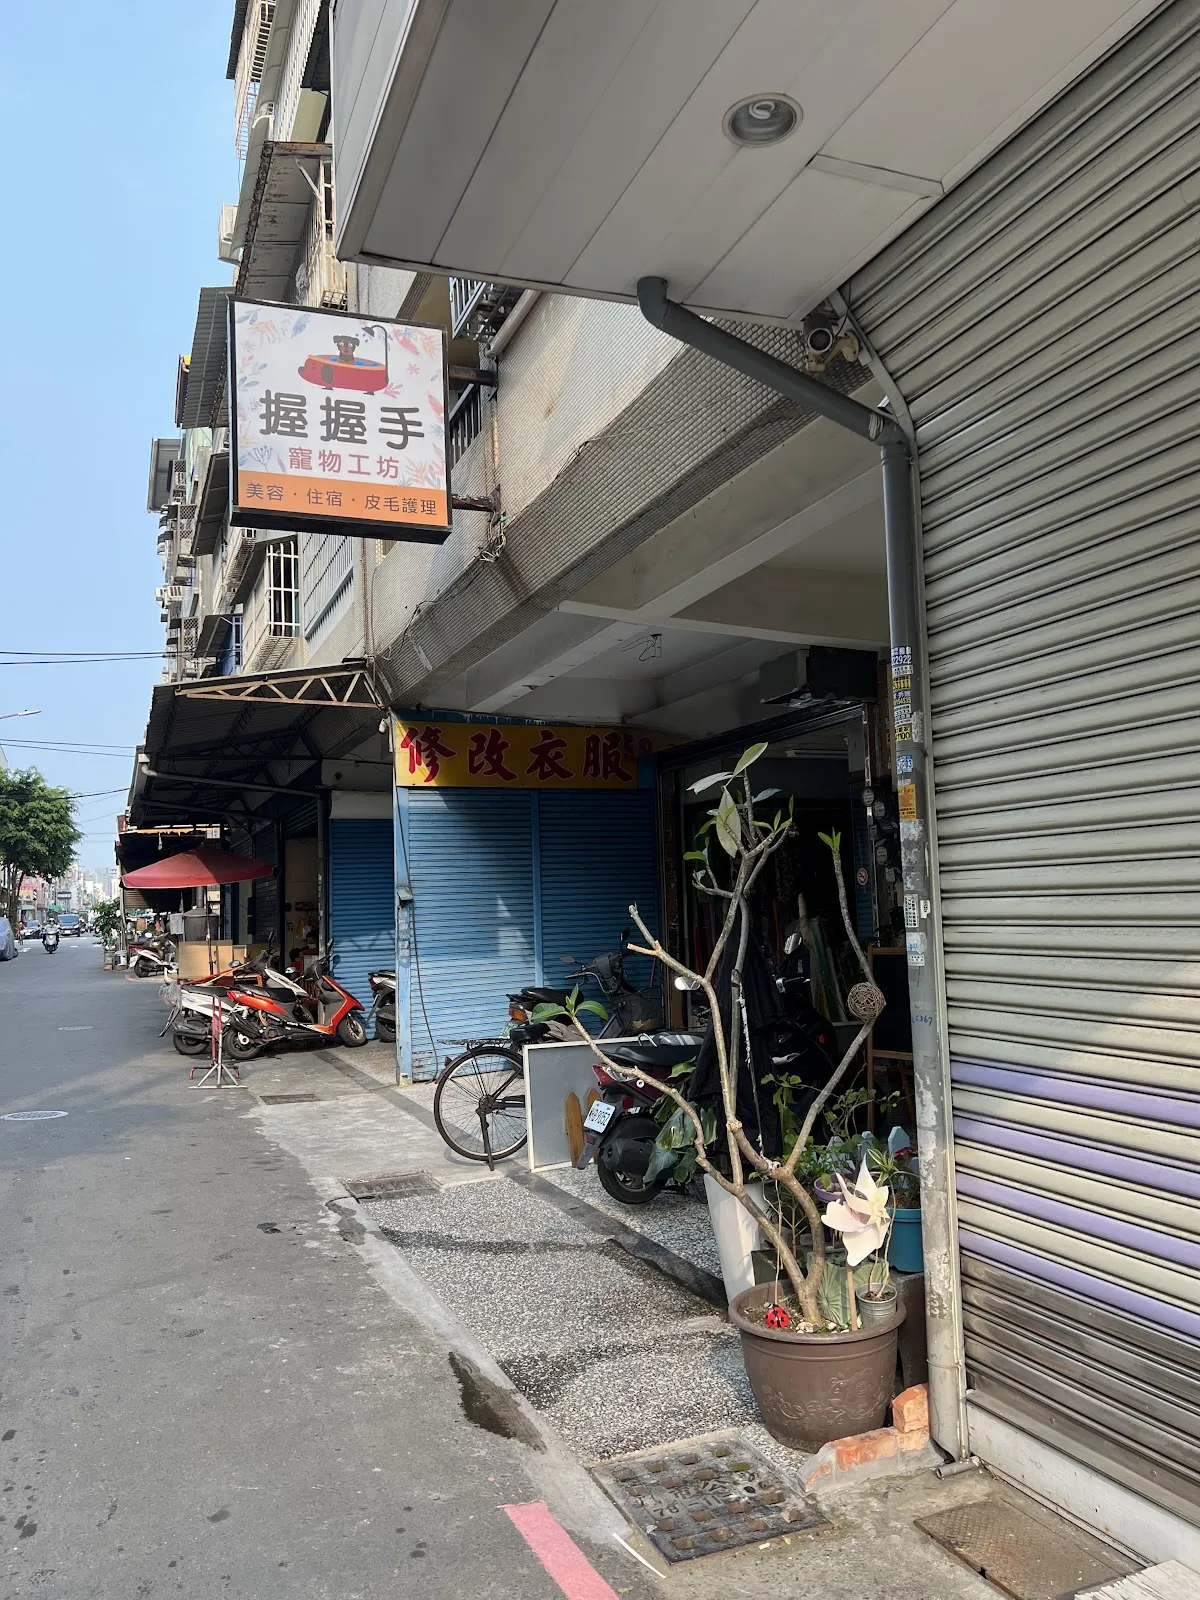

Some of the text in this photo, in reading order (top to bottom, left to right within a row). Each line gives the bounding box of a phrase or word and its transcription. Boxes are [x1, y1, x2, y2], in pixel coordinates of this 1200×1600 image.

[259, 389, 425, 450] 握握手
[288, 446, 400, 480] 寵物工坊
[400, 725, 634, 783] 修改衣服
